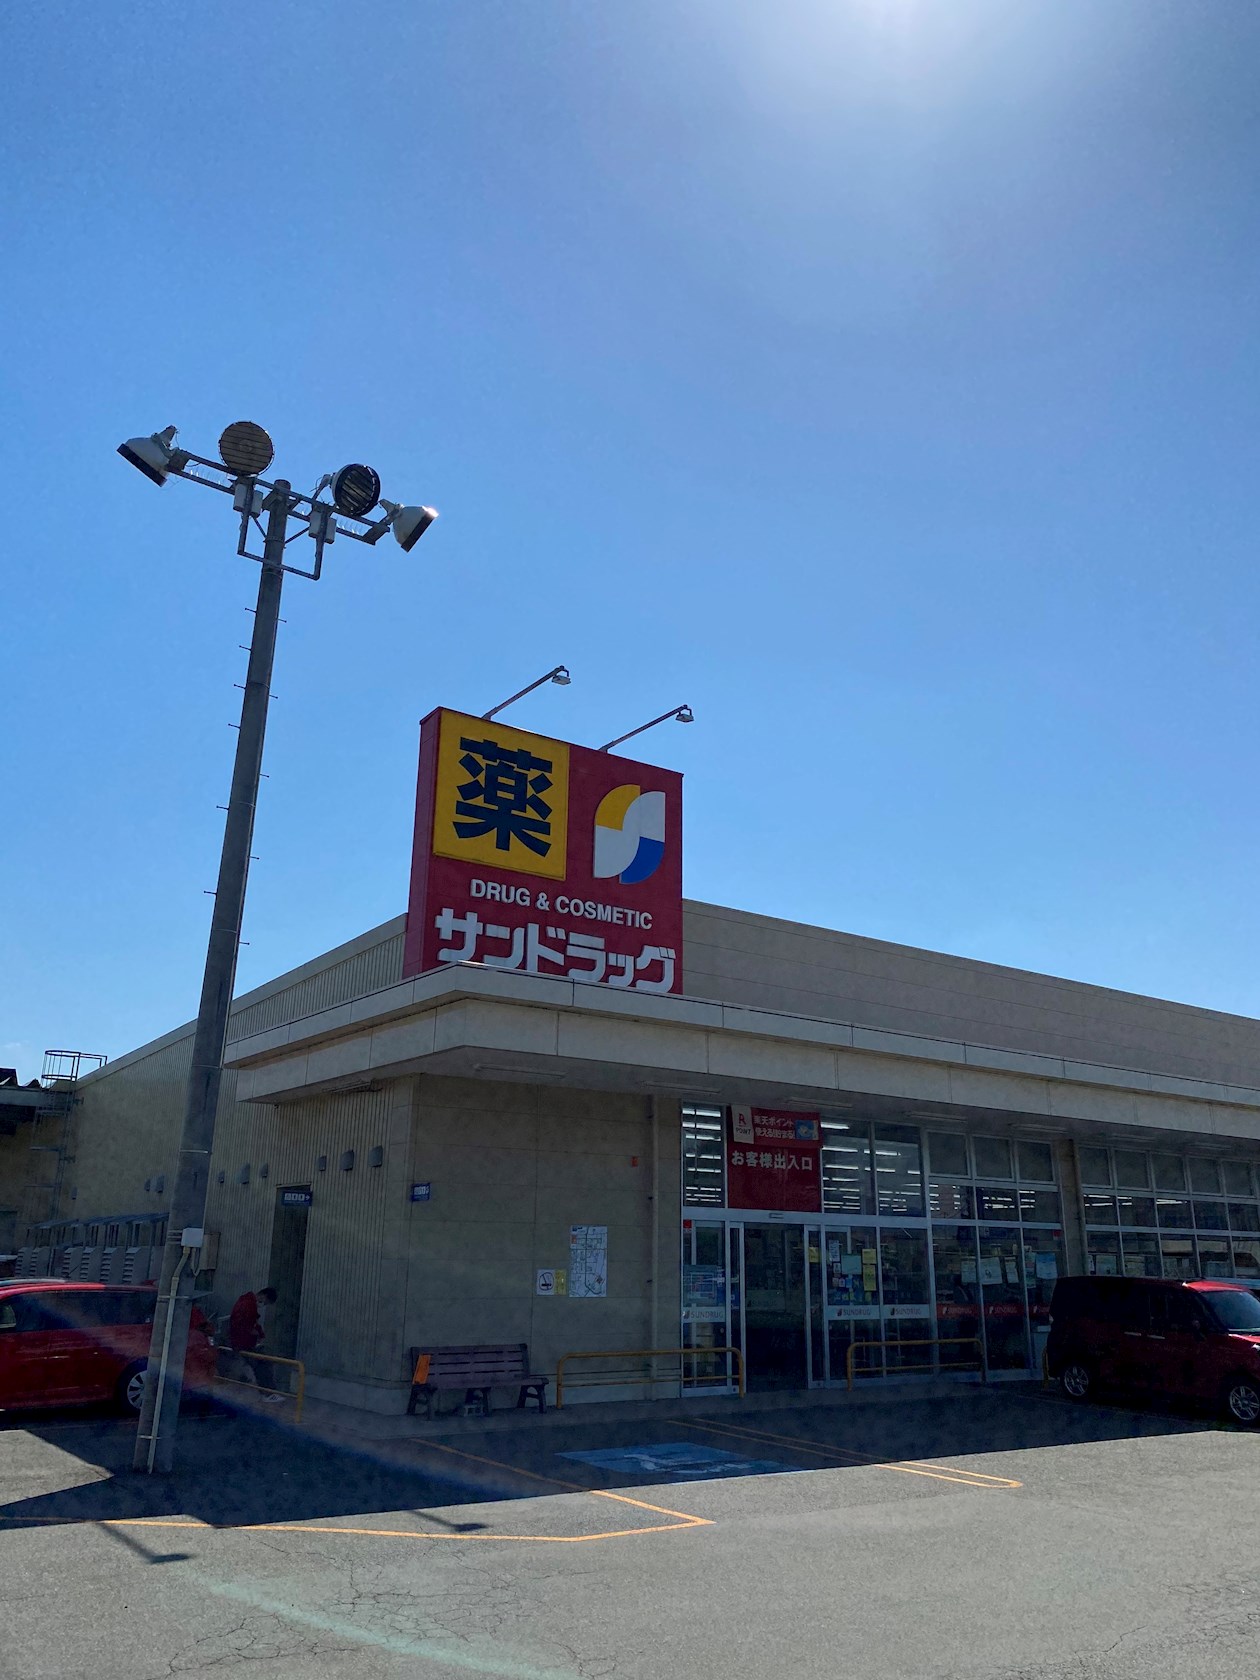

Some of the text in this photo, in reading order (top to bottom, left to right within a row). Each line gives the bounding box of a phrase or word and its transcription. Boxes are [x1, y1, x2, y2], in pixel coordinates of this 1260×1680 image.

[453, 736, 553, 857] 薬
[470, 878, 653, 930] DRUG & COSMETIC
[435, 907, 676, 993] サンドラッグ
[753, 1116, 794, 1128] 楽天ポイント
[735, 1127, 751, 1135] POINT
[731, 1151, 812, 1170] お客様出入口
[691, 1310, 725, 1319] SUNDRUG
[842, 1307, 871, 1316] SUNDRUG
